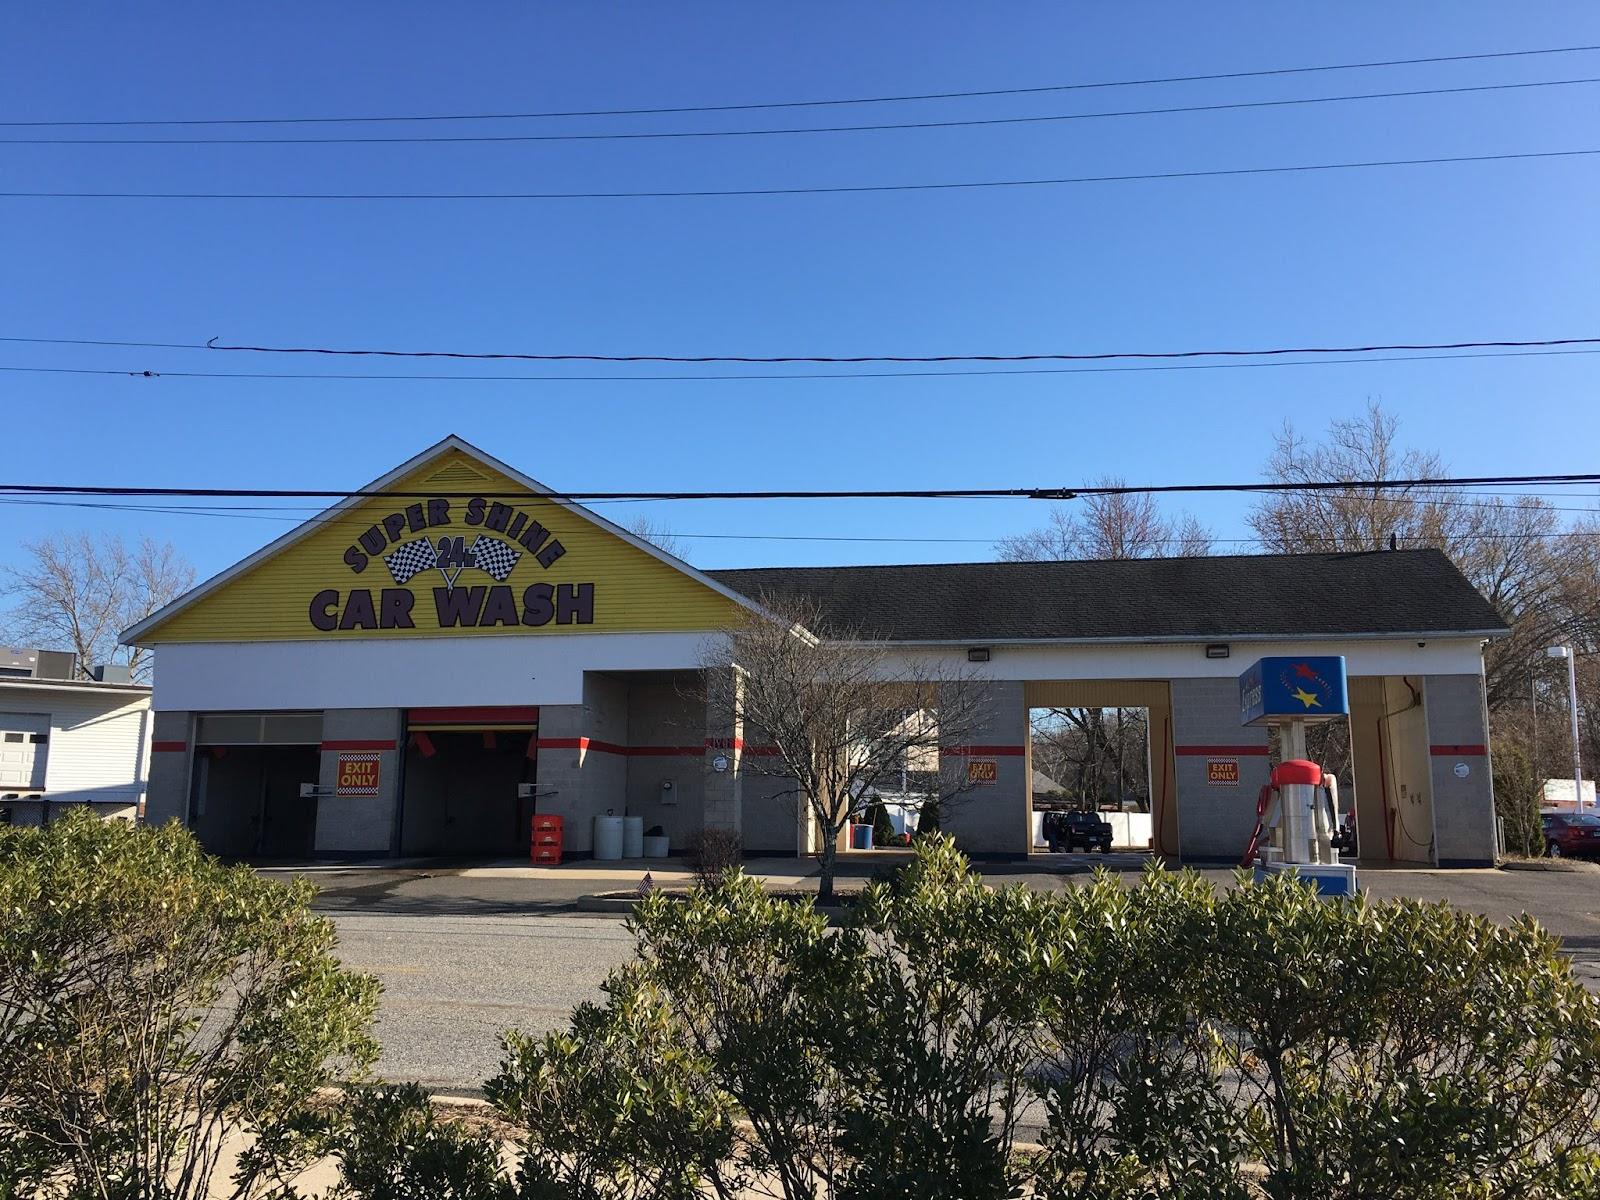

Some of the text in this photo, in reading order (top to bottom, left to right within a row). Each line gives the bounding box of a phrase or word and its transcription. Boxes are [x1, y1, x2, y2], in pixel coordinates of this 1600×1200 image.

[344, 497, 567, 574] SUPER SHINE
[309, 583, 594, 631] CAR WASH
[345, 762, 373, 774] EXIT
[972, 763, 993, 771] EXIT
[1212, 763, 1234, 771] EXIT
[340, 774, 376, 786] ONLY
[970, 771, 994, 779] ONLY
[1210, 771, 1236, 780] ONLY
